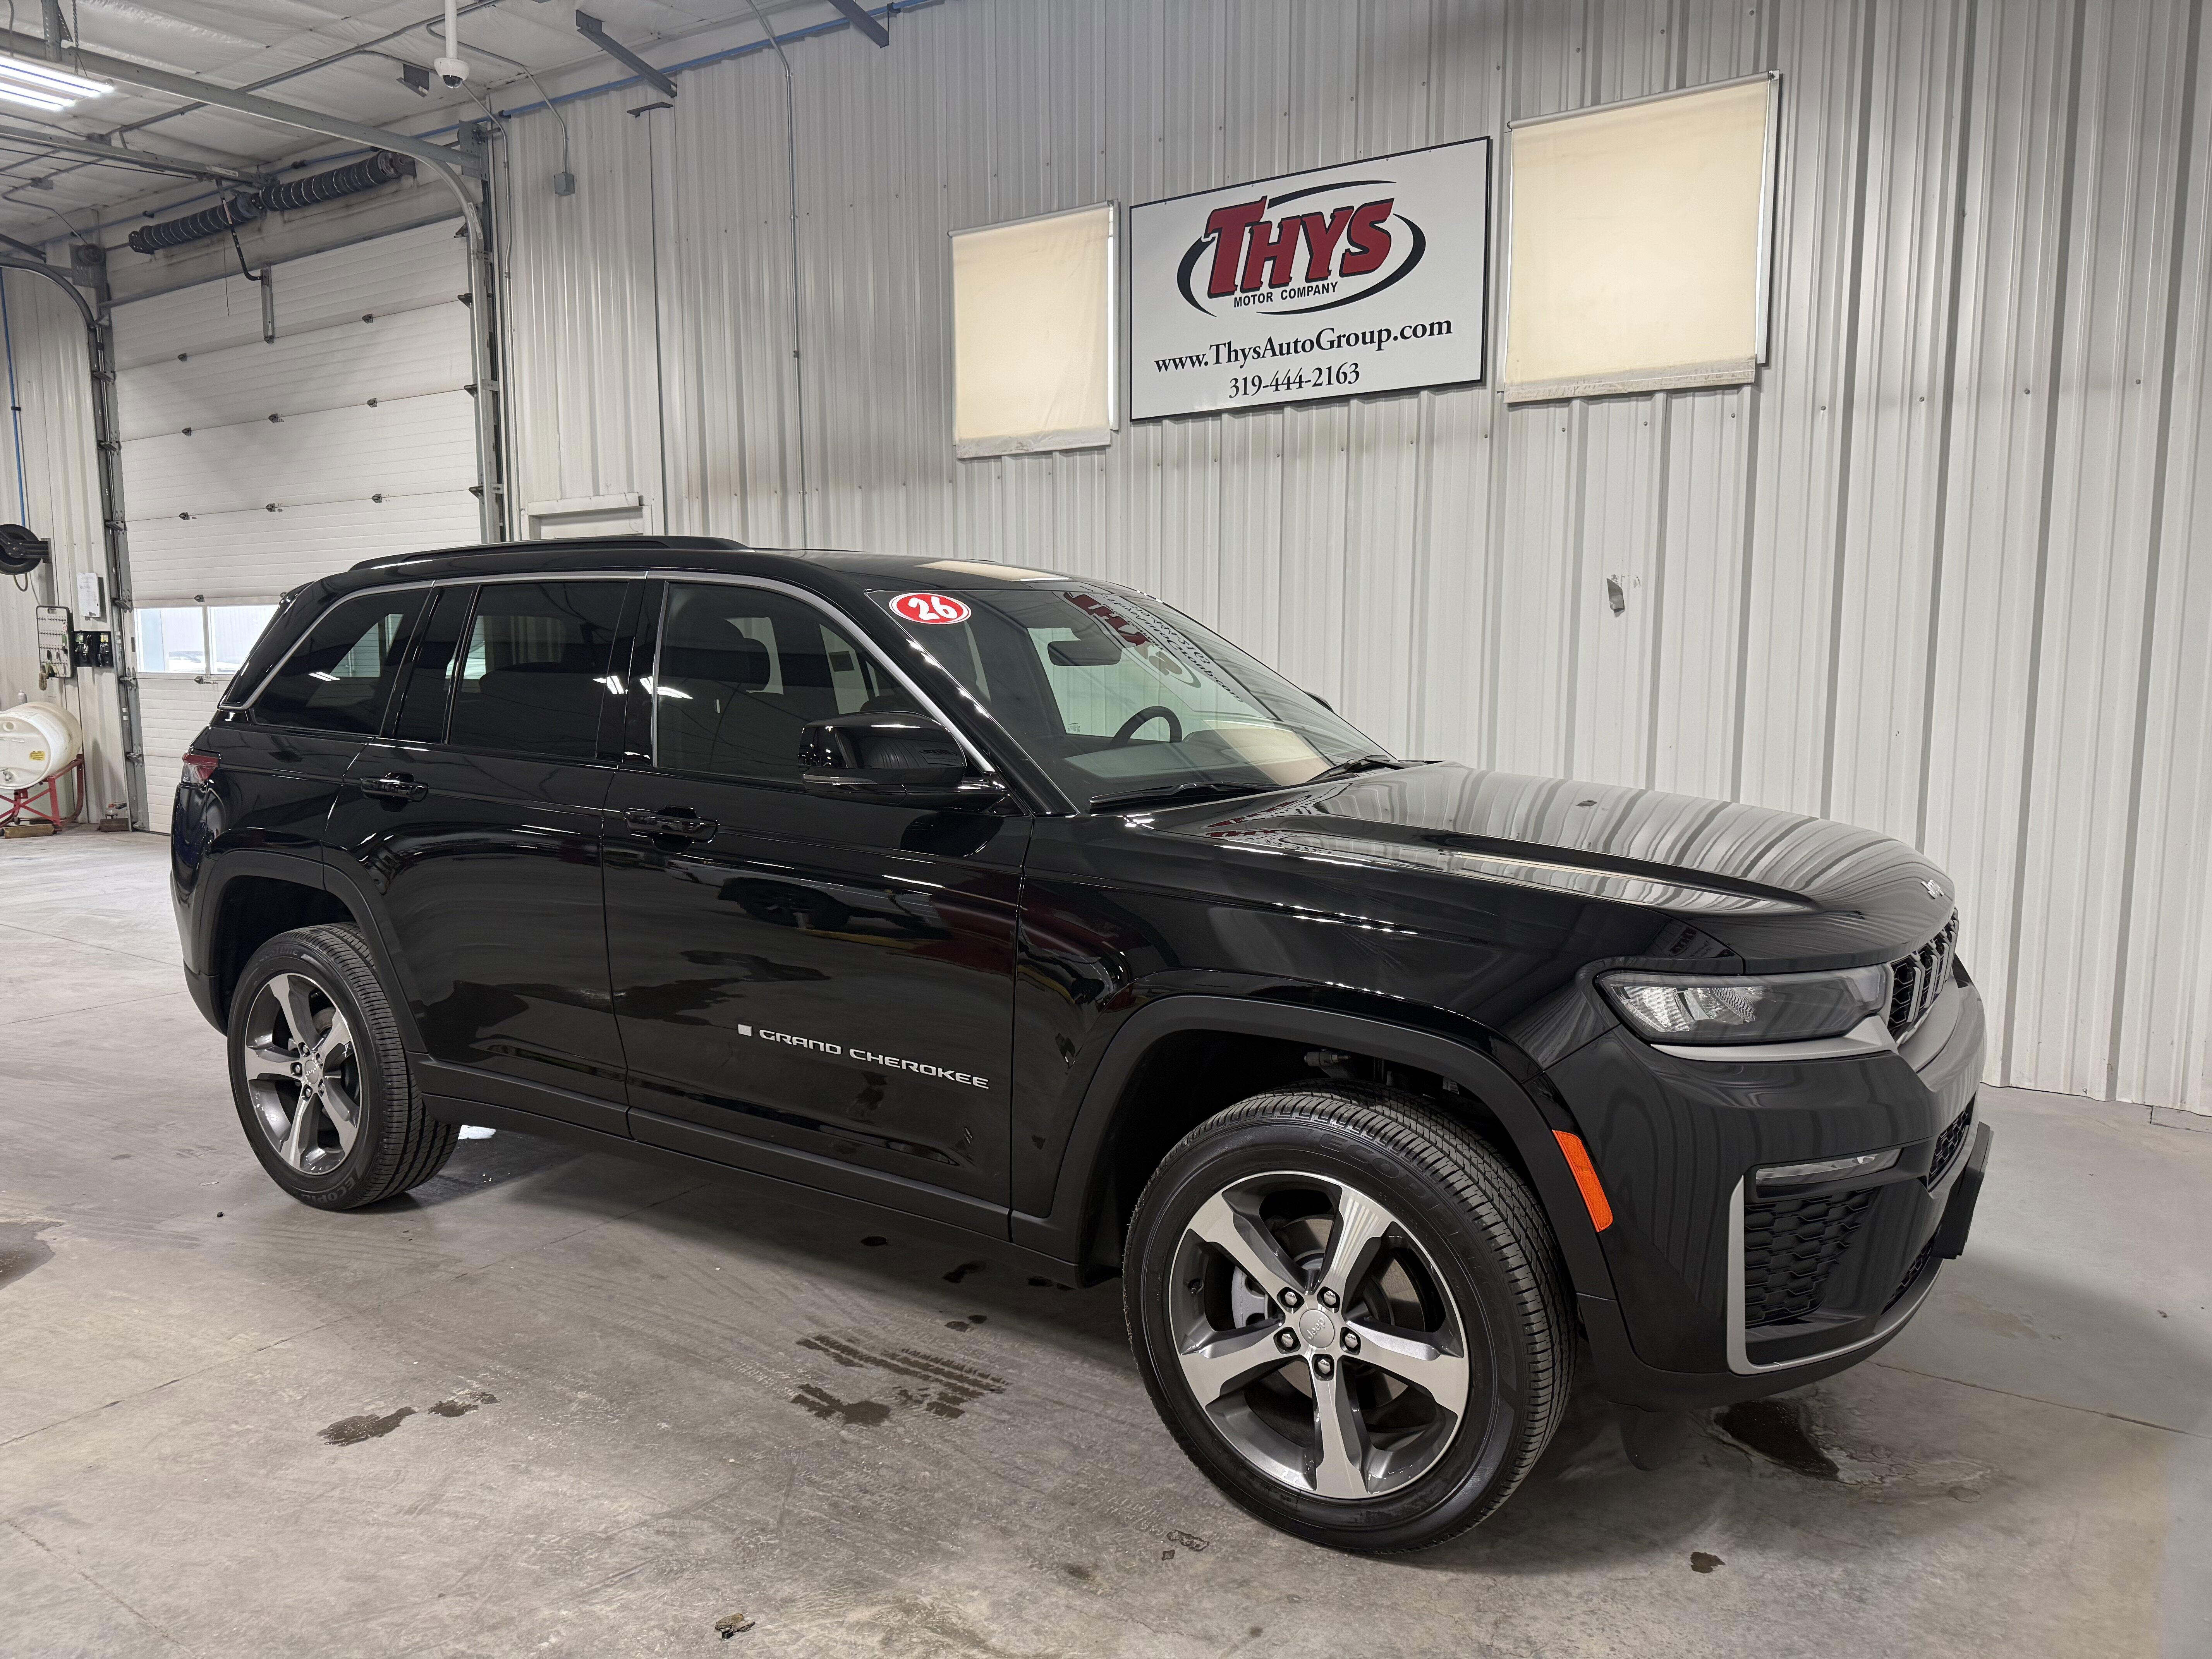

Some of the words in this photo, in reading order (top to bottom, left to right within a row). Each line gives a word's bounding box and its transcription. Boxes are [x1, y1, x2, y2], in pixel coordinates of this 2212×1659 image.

[1201, 195, 1395, 299] THYS
[1233, 292, 1273, 308] MOTOR
[1280, 281, 1338, 301] COMPANY
[1154, 319, 1453, 373] www.ThysAutoGroup.com
[1229, 362, 1360, 399] 319-444-2163
[908, 596, 958, 620] 26
[759, 1029, 842, 1054] GRAND
[849, 1048, 989, 1089] CHEROKEE
[1307, 1317, 1326, 1340] Jeep
